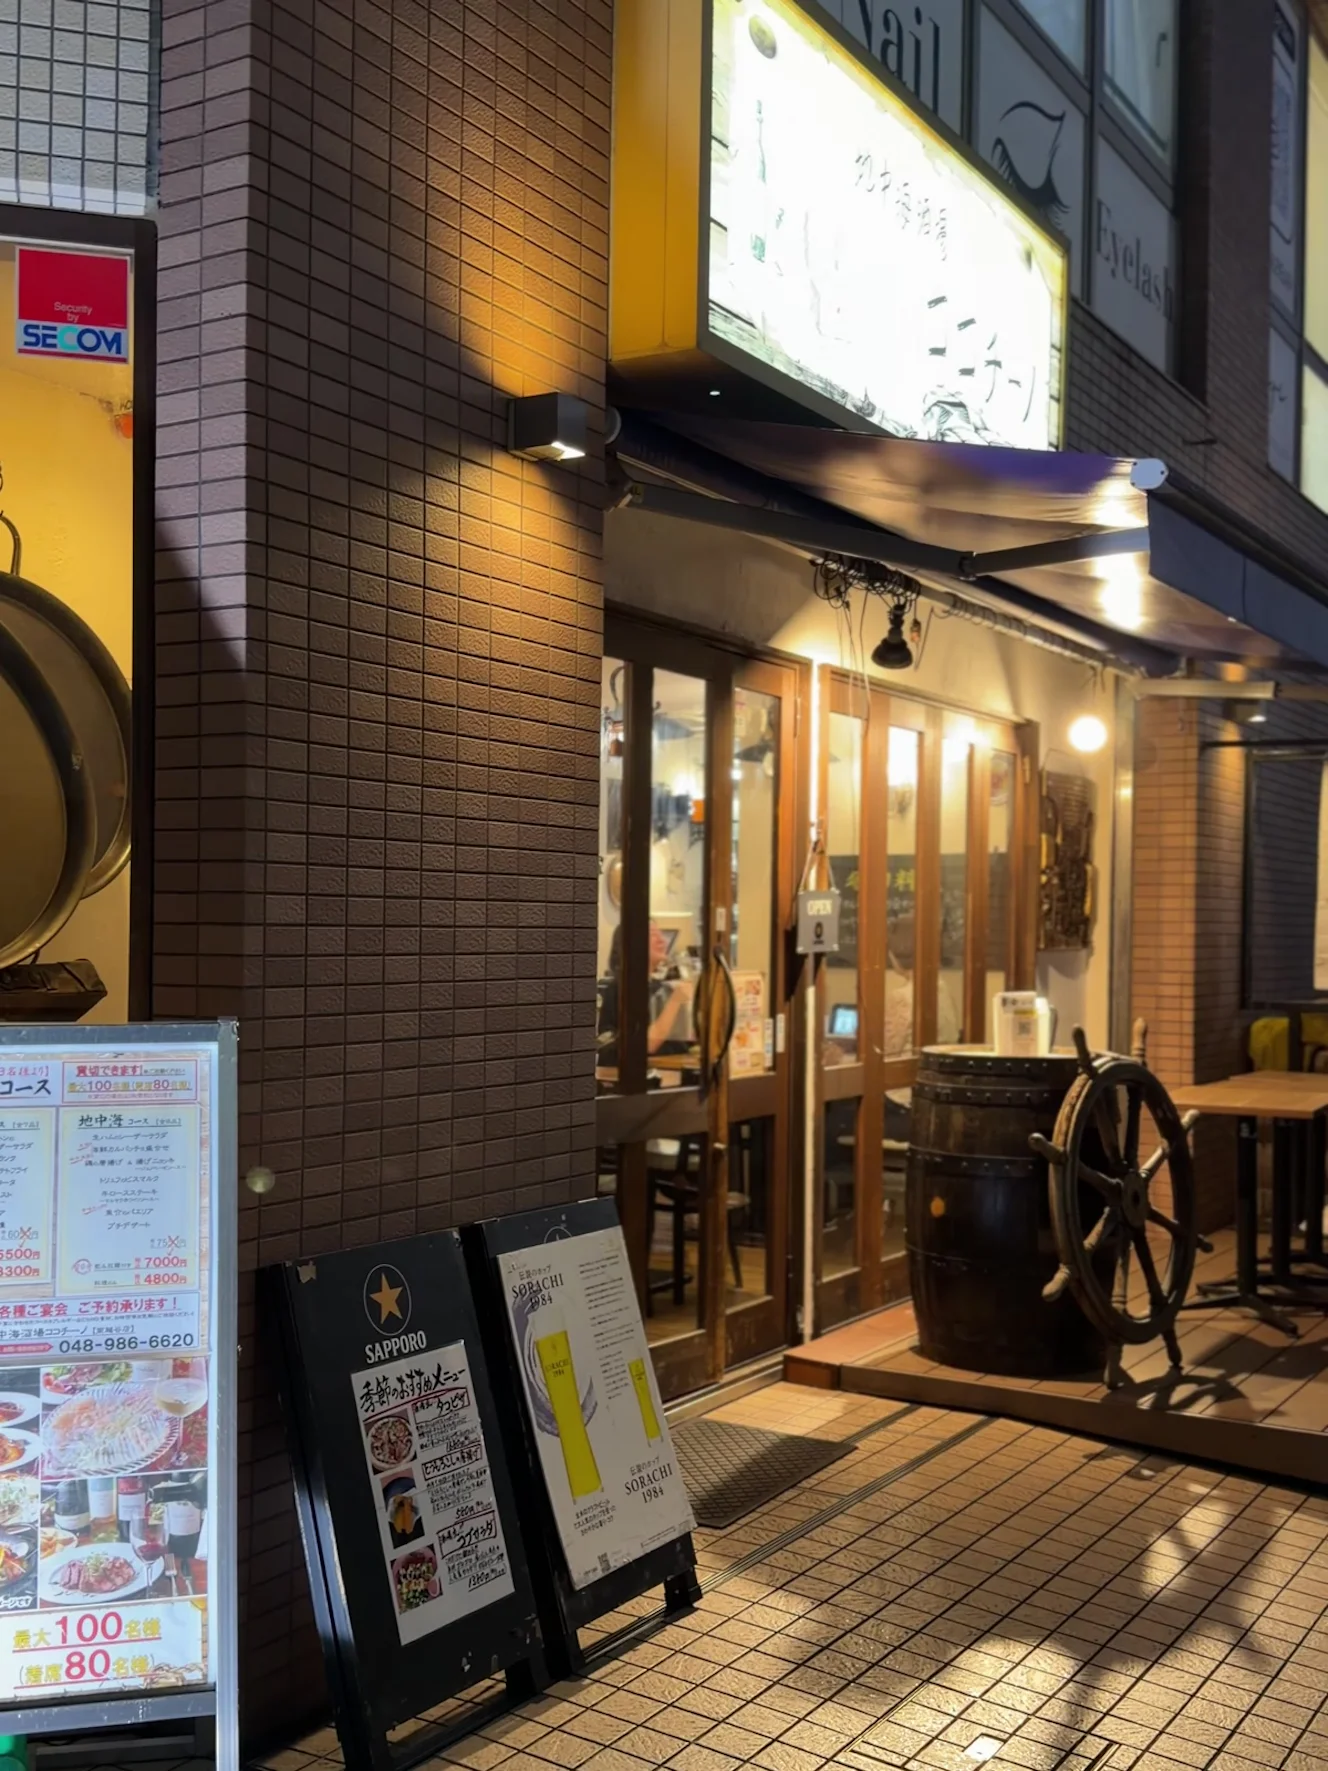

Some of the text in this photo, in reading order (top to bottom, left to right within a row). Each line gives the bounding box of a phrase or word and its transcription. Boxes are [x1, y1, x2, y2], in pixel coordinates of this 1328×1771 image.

[1096, 198, 1174, 322] Eyelash
[54, 301, 93, 316] Security
[66, 312, 79, 323] by
[23, 323, 122, 355] SECOM
[0, 1079, 52, 1095] コース
[78, 1113, 124, 1128] 地中海
[144, 1272, 188, 1285] 4800円
[511, 1272, 565, 1300] SORACHI
[0, 1302, 69, 1318] 各種ご宴会
[78, 1296, 178, 1314] ご予約承ります！
[59, 1333, 194, 1354] 048-986-6620
[364, 1329, 428, 1365] SAPPORO
[359, 1363, 467, 1414] 季節のおすすめメニュー
[624, 1462, 673, 1496] SORACHI
[642, 1486, 664, 1504] 1984
[13, 1611, 162, 1649] 最大100名様
